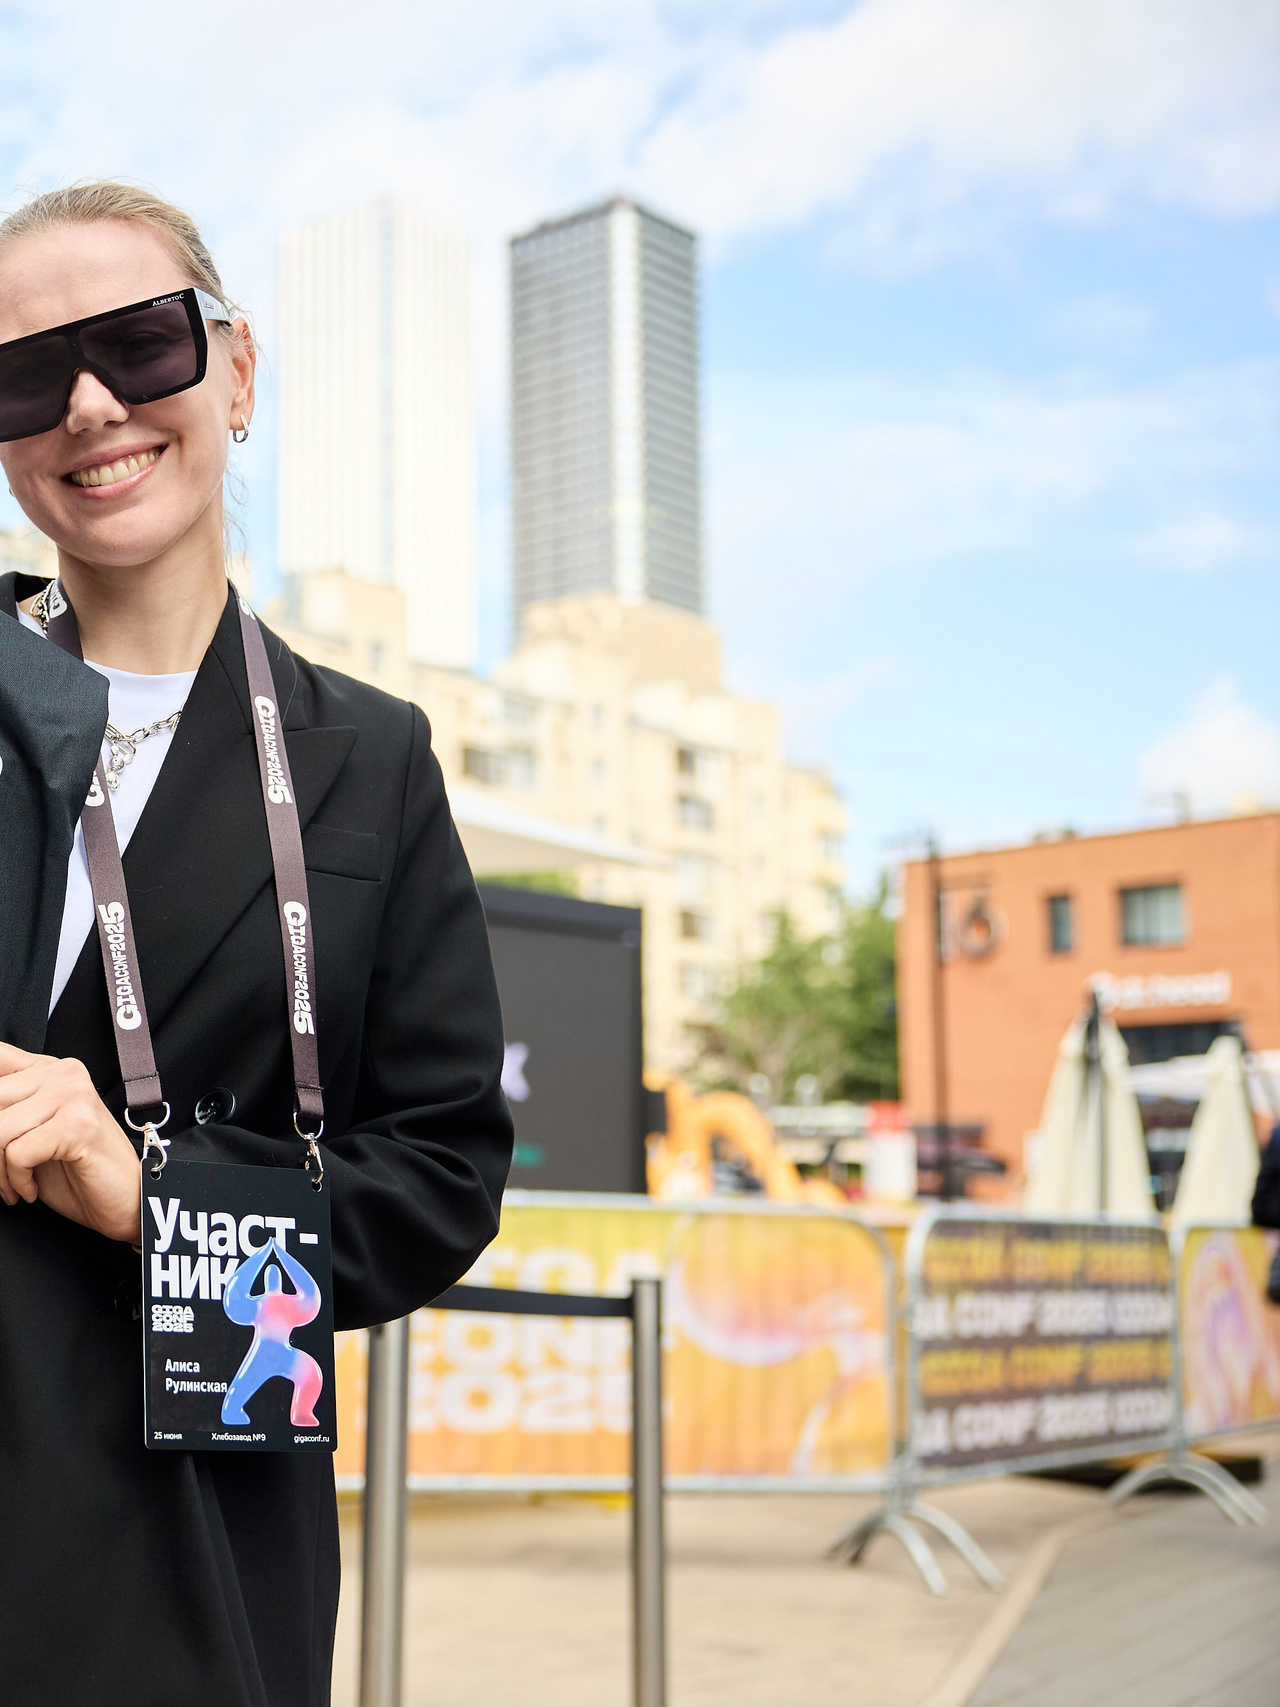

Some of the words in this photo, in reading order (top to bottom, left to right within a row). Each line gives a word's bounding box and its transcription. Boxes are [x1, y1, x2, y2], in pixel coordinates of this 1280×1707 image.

[254, 695, 294, 804] GIGACONF2025
[97, 901, 142, 1031] GIGACONF2025
[283, 900, 315, 1035] GIGACONF2025
[147, 1195, 319, 1259] Участ-
[151, 1304, 194, 1315] GIGA
[151, 1313, 194, 1323] CONF
[152, 1322, 194, 1333] 2025
[165, 1358, 200, 1373] Алиса
[165, 1377, 228, 1394] Рулинская
[153, 1431, 163, 1440] 25
[163, 1432, 183, 1441] июня
[211, 1432, 252, 1443] Хлебозавод
[294, 1434, 330, 1444] gigaconf.ru
